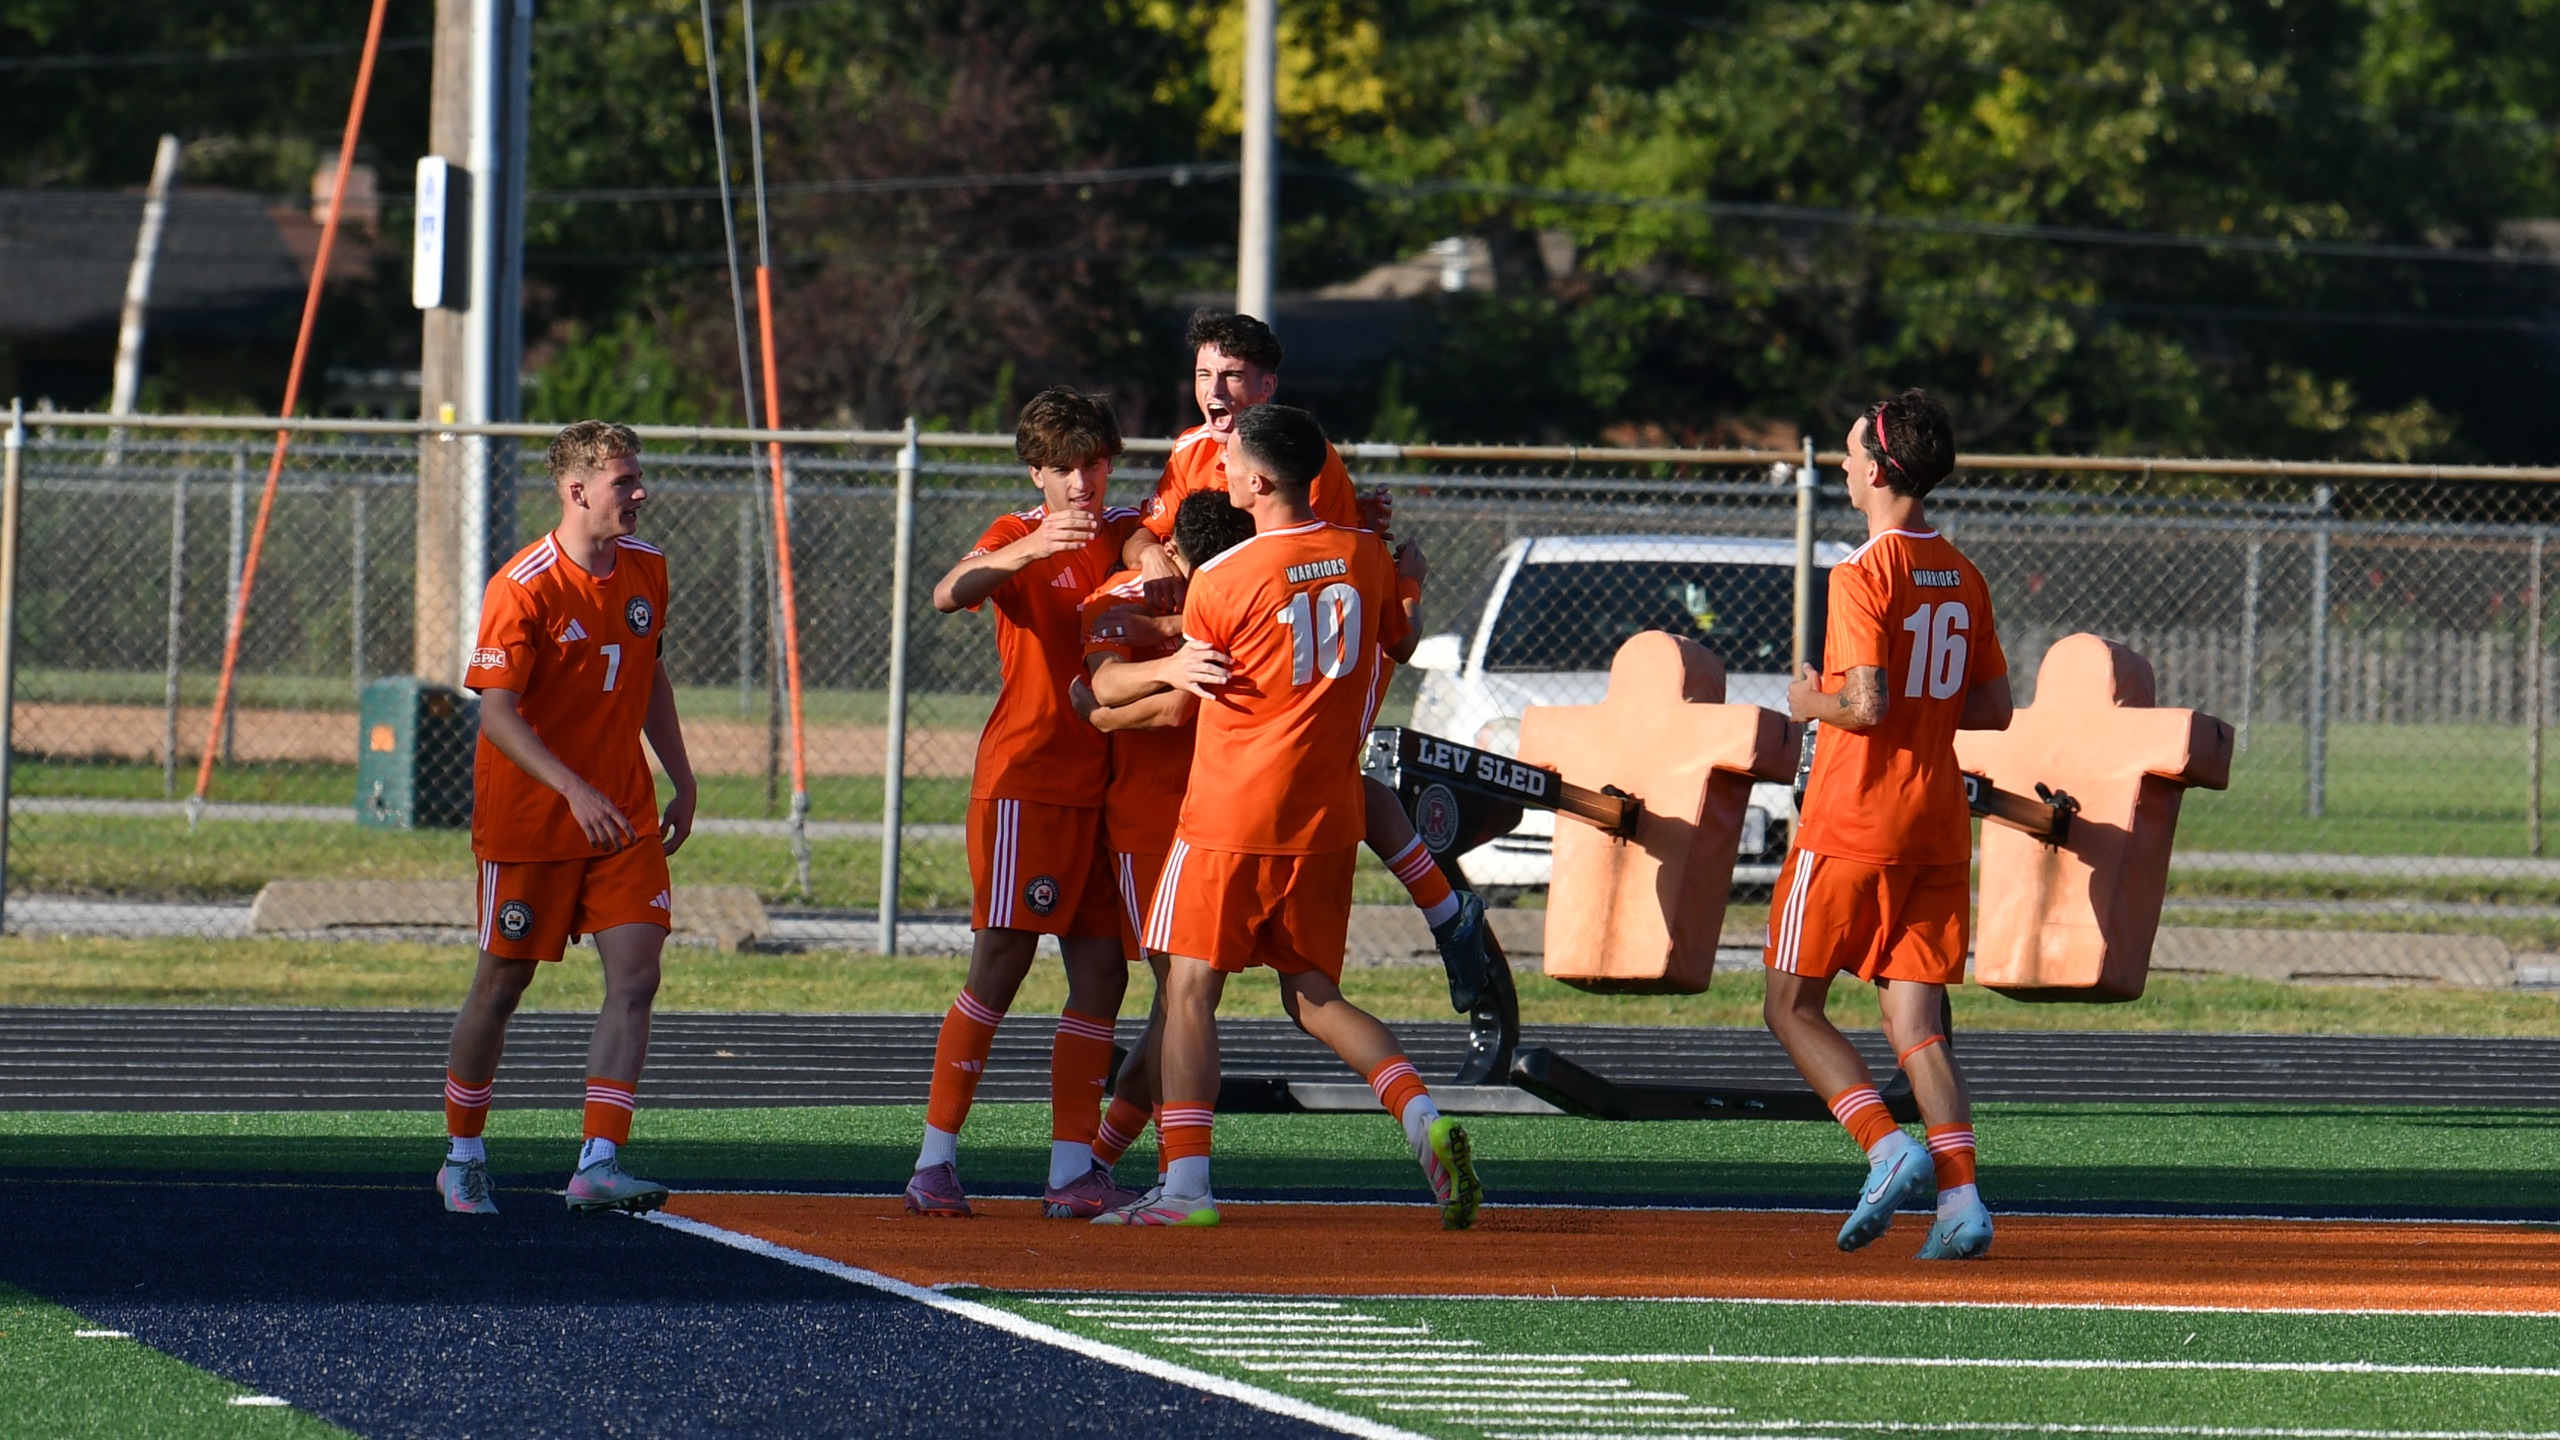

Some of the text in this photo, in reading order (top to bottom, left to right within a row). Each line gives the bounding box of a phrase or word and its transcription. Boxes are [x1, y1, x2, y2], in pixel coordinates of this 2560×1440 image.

[1285, 558, 1347, 583] WARRIORS
[1912, 569, 1960, 587] WARRIORS
[472, 652, 504, 665] GPAC
[1276, 583, 1361, 686] 10
[1903, 601, 1969, 699] 16
[600, 643, 620, 692] 7
[1417, 738, 1546, 797] LEV SLED
